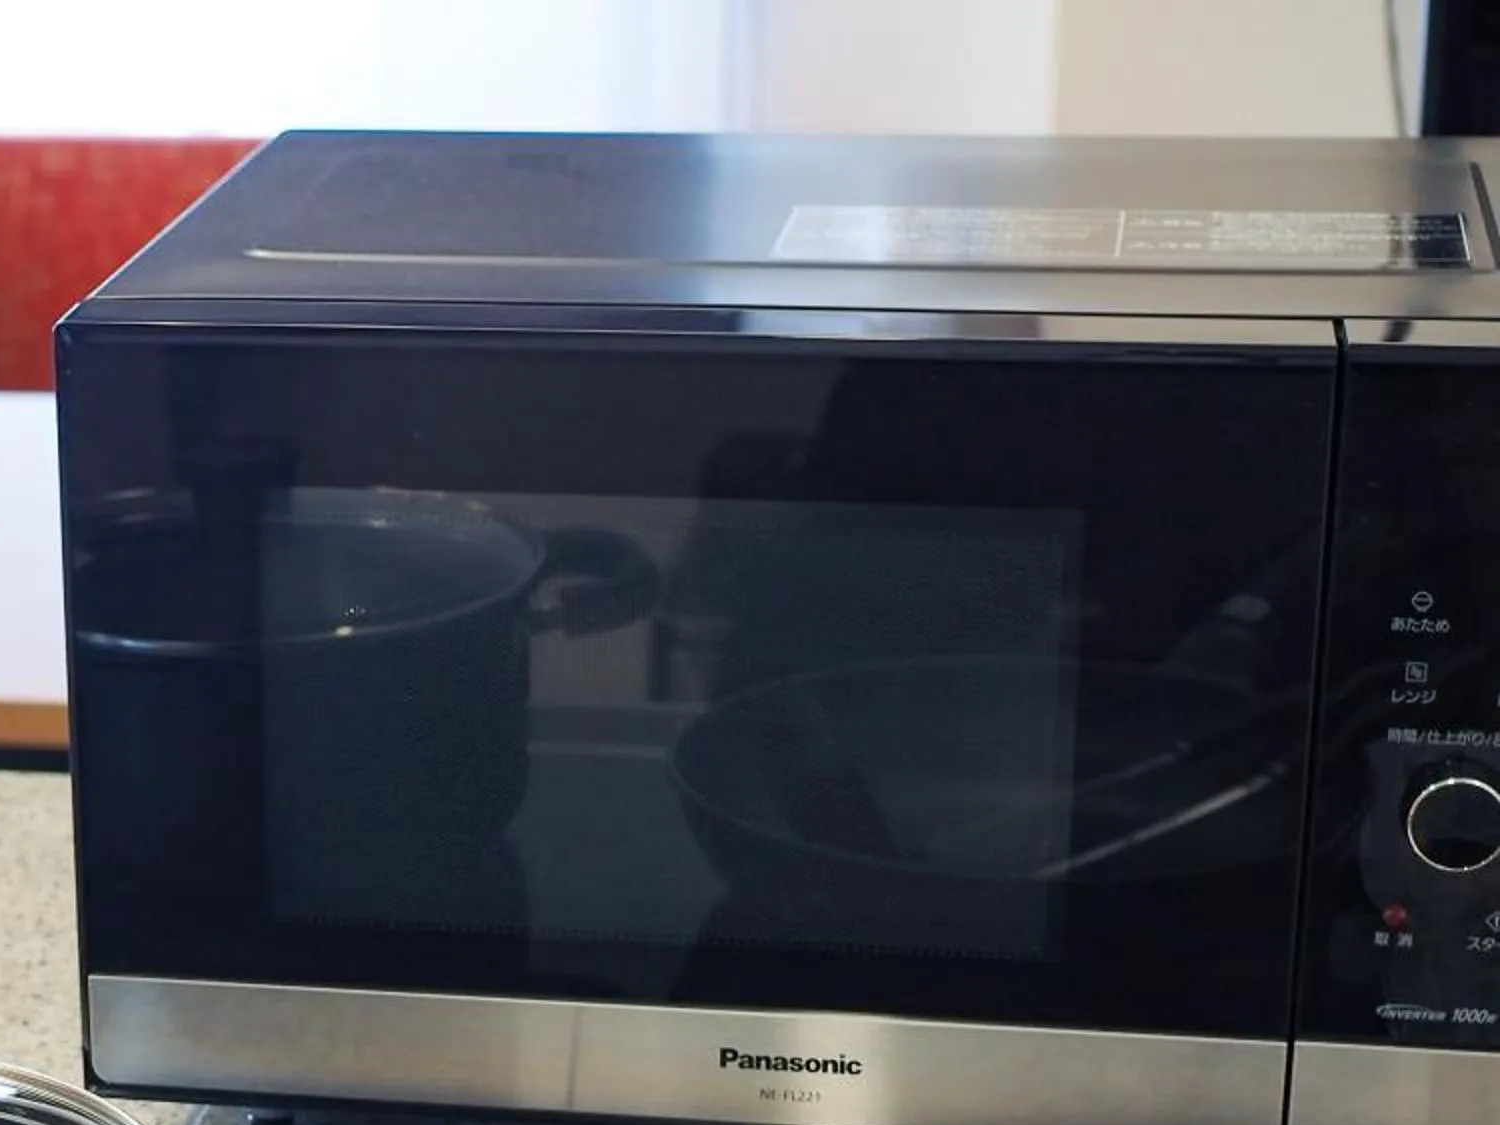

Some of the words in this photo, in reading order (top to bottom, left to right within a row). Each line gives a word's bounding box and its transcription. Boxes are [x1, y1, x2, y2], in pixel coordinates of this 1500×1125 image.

[1390, 616, 1451, 633] あたため
[1391, 688, 1437, 704] レンジ
[719, 1047, 863, 1075] Panasonic
